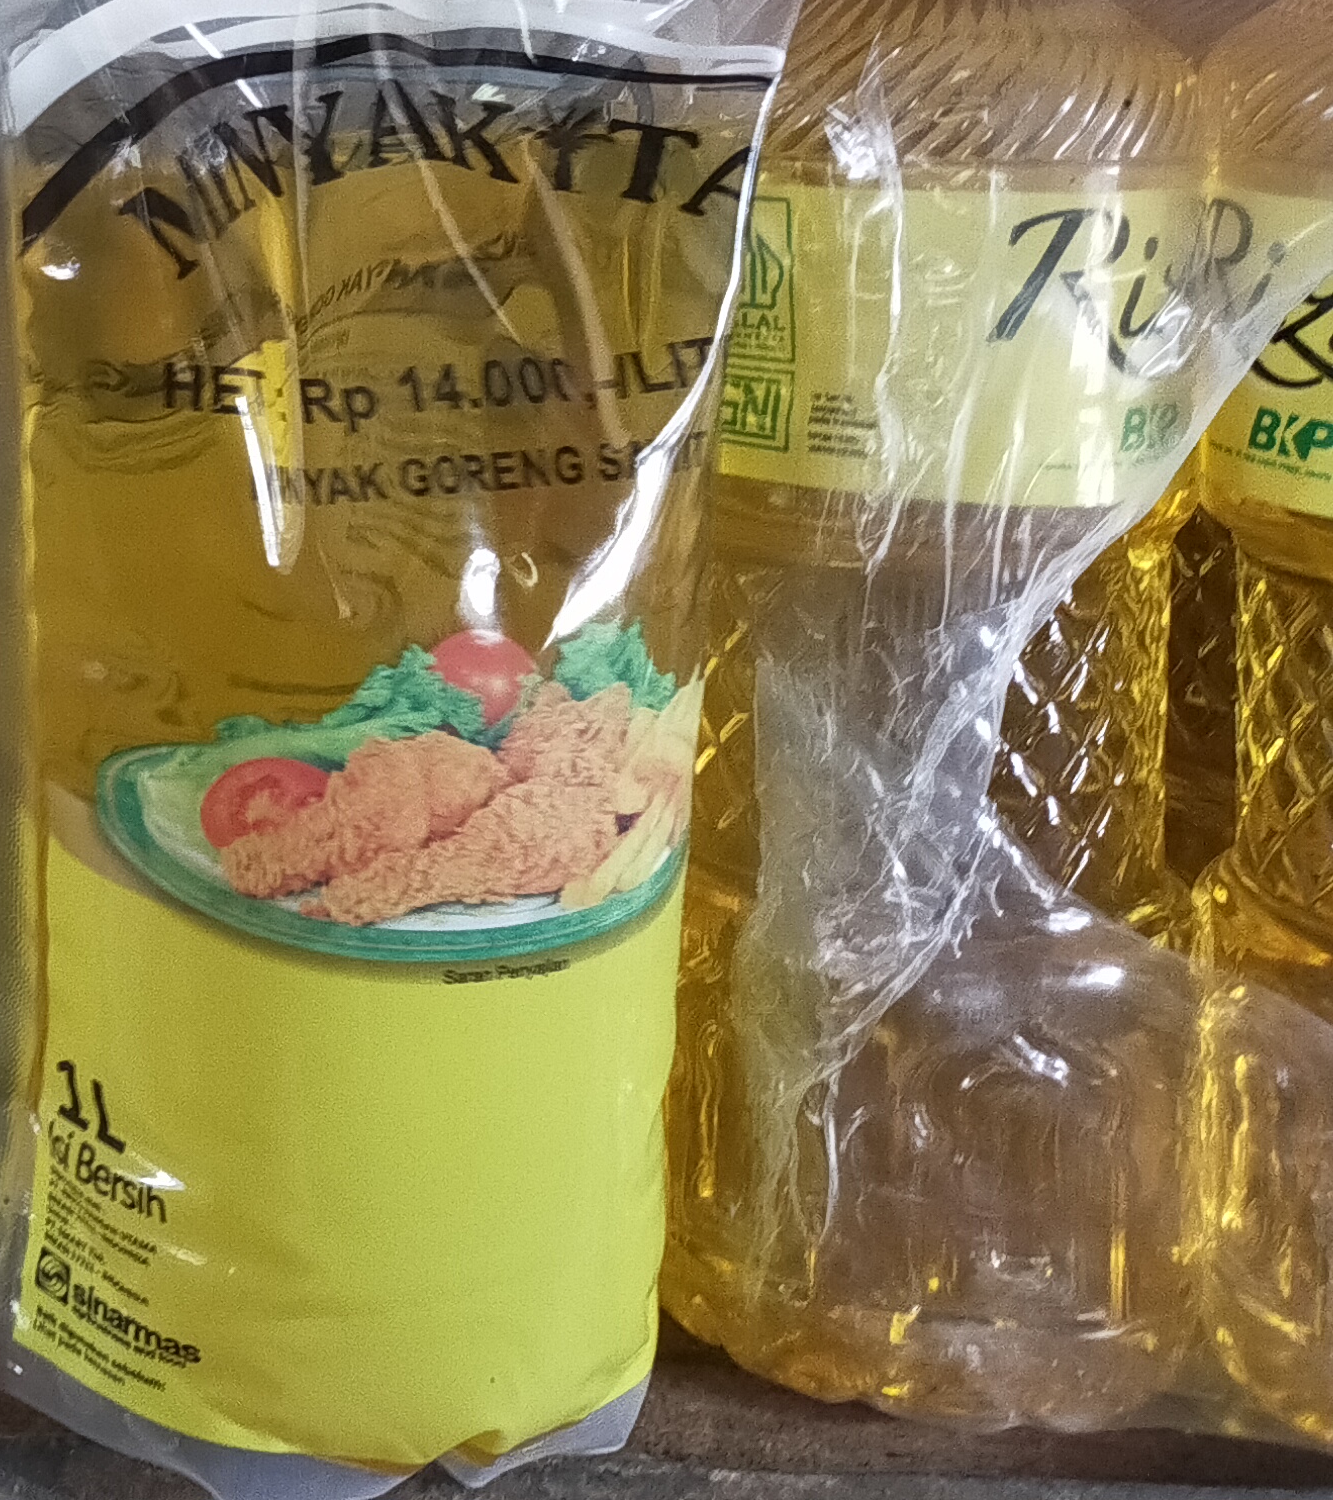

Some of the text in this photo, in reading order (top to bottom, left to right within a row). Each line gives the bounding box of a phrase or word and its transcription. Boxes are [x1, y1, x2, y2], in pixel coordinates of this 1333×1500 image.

[299, 377, 378, 436] Rp
[397, 444, 584, 496] GORENG
[75, 1140, 168, 1224] Bersih
[73, 1284, 202, 1364] sinarmas
